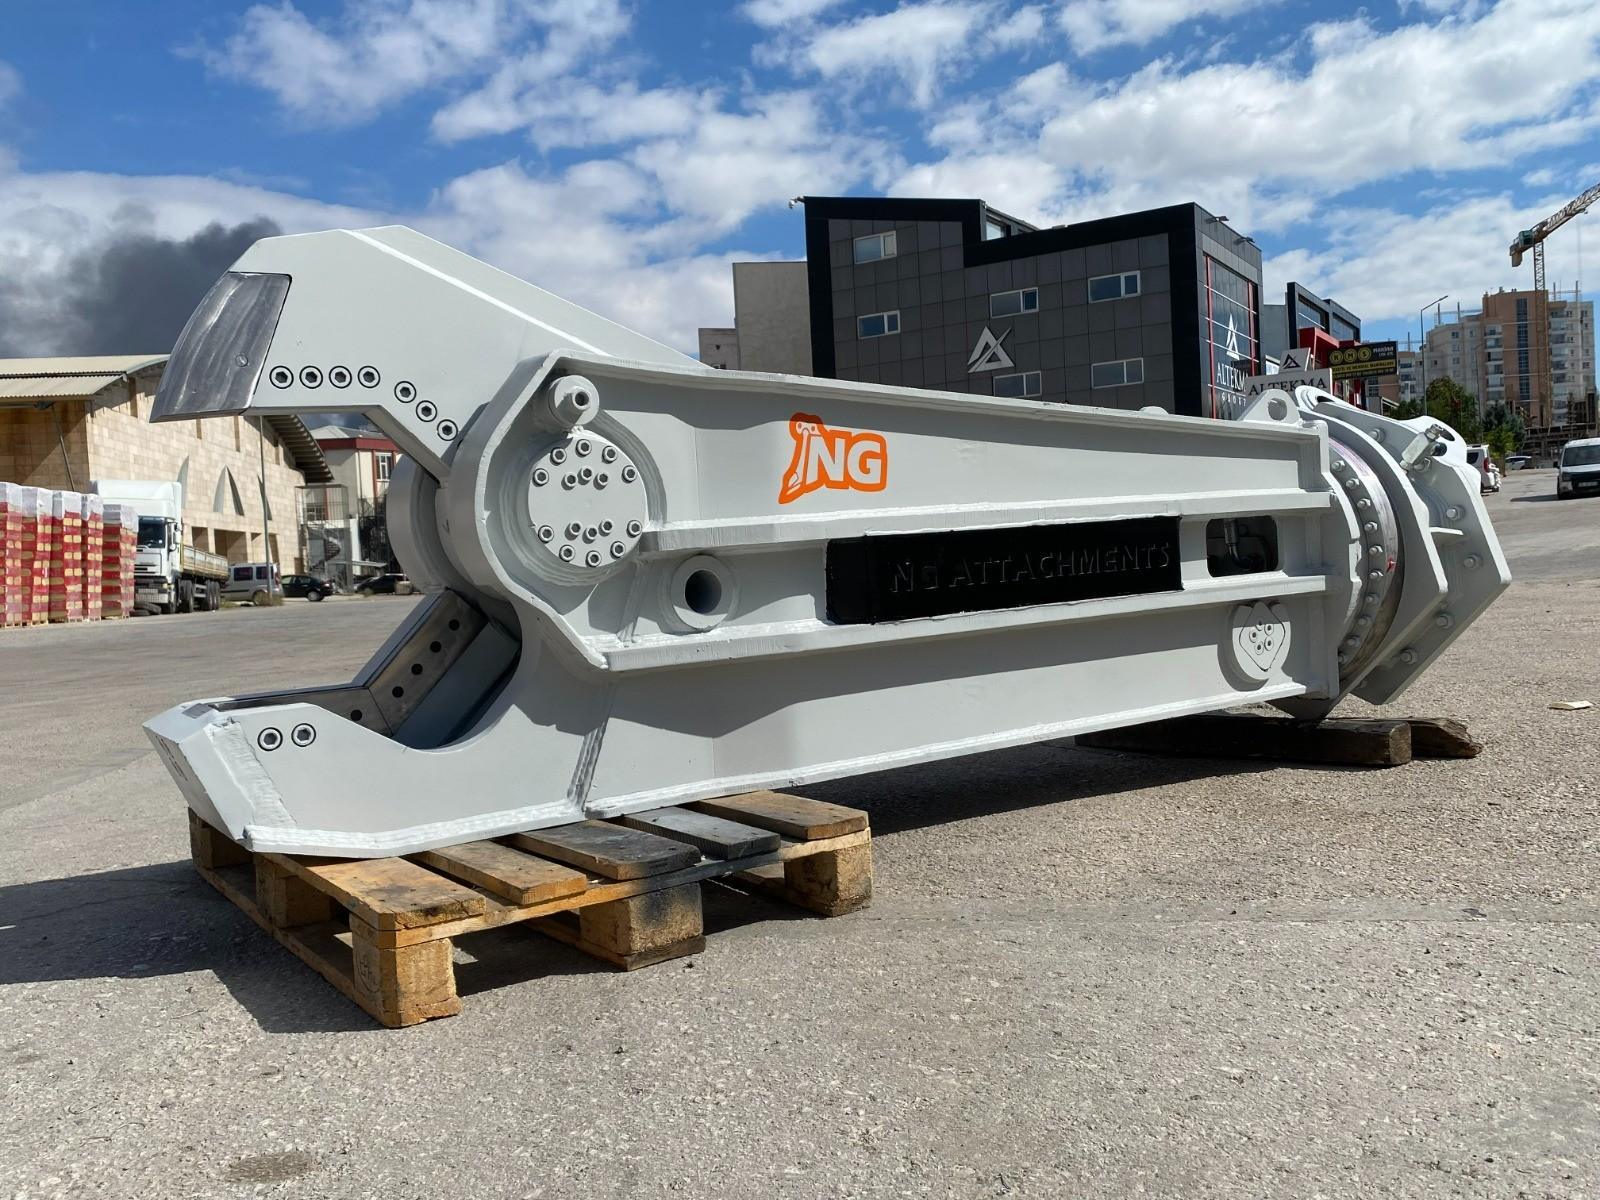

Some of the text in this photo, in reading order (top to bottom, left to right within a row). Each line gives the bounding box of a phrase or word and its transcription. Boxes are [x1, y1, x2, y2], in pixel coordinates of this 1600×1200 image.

[1216, 361, 1249, 392] ALTEKM
[804, 432, 884, 486] NG
[948, 541, 1170, 588] ATTACHMENTS
